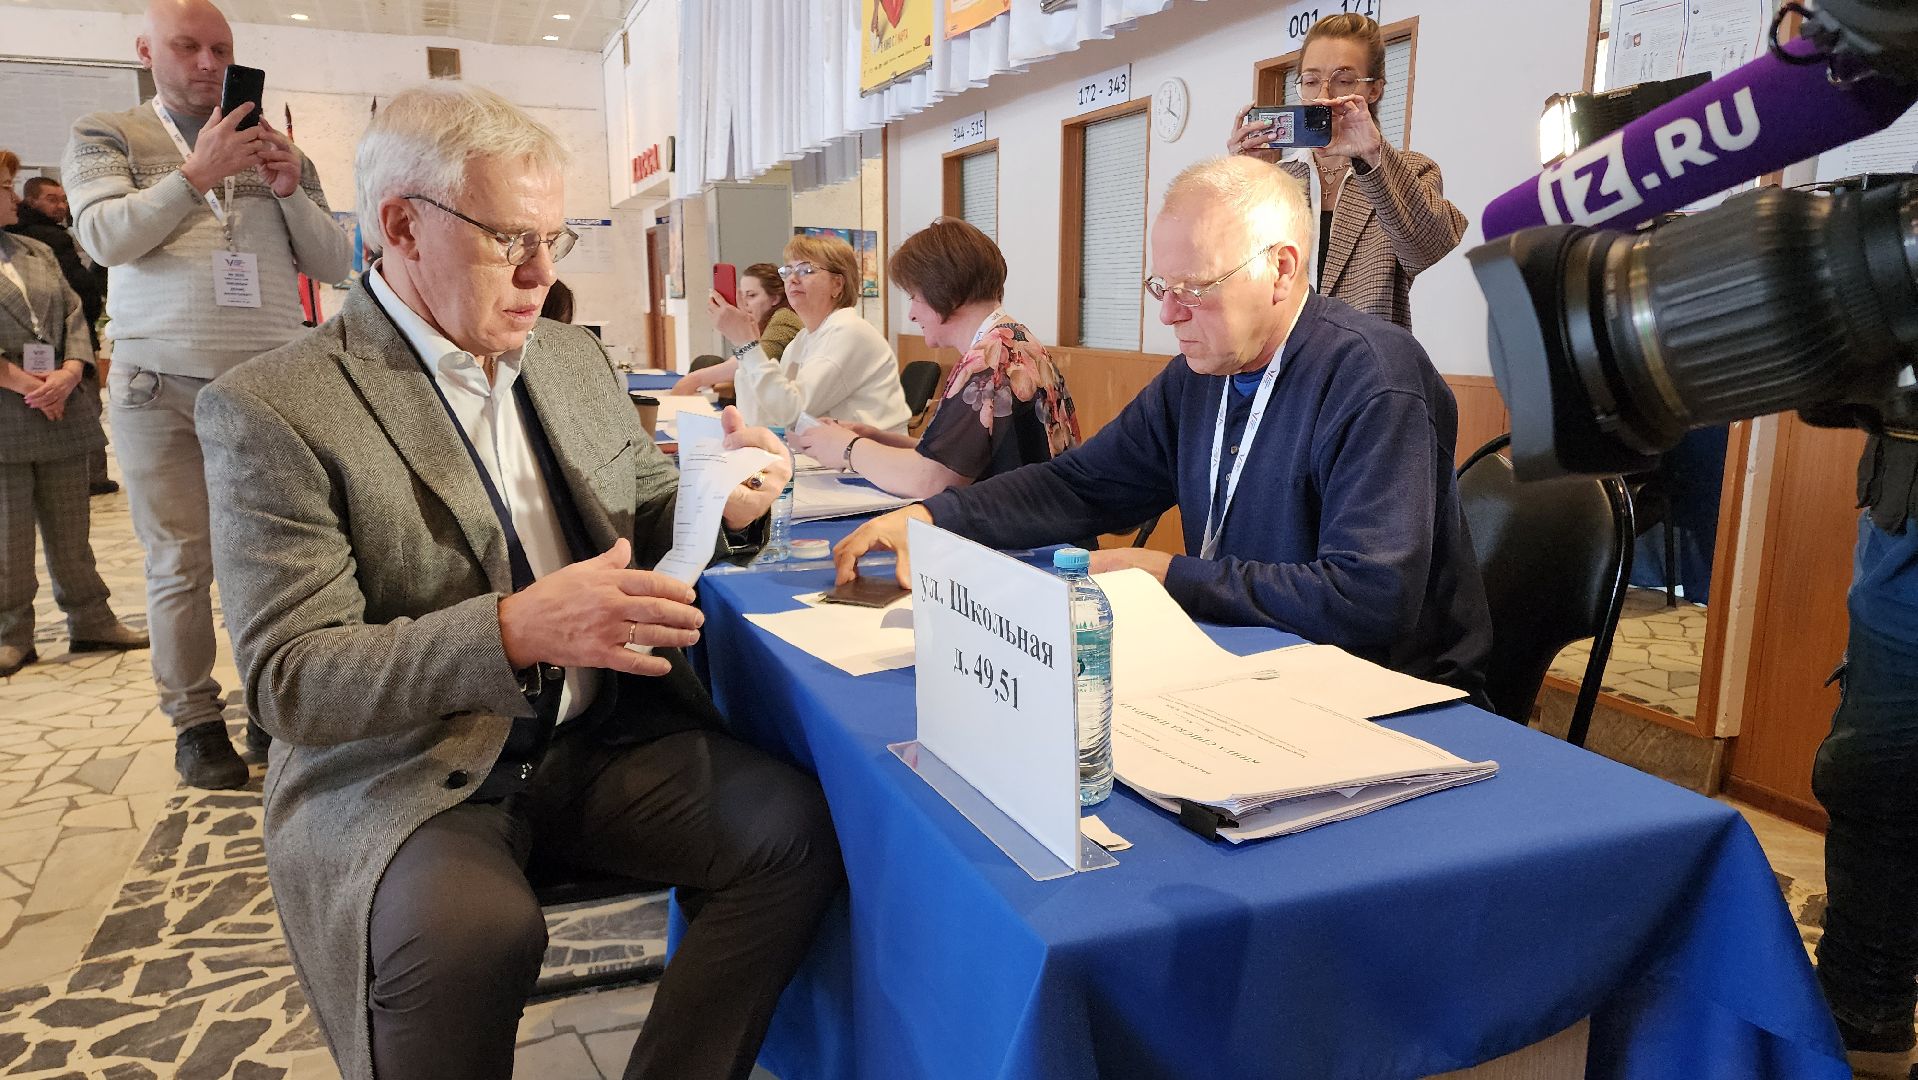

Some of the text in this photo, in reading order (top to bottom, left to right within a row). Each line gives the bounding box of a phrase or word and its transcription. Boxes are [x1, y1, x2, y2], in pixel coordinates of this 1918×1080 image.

[1078, 83, 1096, 106] 172
[1108, 73, 1127, 97] 343
[952, 125, 965, 142] 344
[971, 119, 984, 137] 515
[919, 573, 1055, 670] ул. Школьная
[953, 647, 1020, 712] д. 49,51
